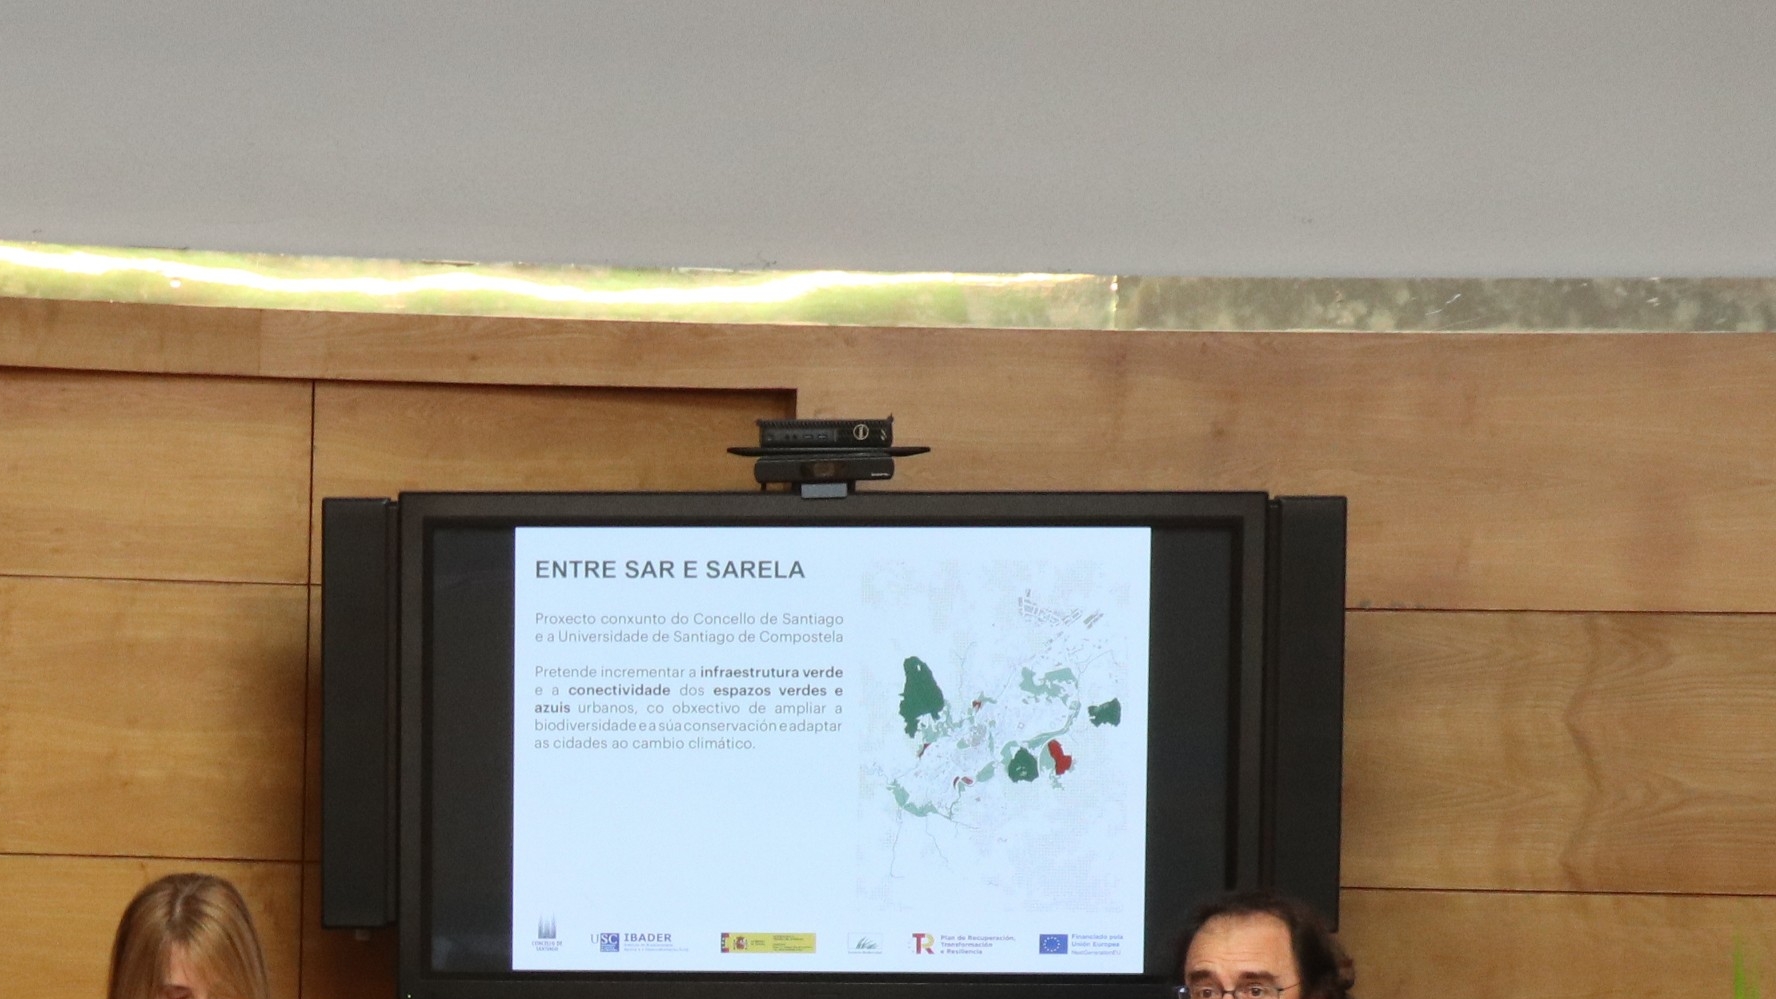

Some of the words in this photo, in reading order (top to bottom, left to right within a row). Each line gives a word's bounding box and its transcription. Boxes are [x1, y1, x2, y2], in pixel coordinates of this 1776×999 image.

[535, 560, 617, 579] ENTRE
[624, 560, 675, 579] SAR
[683, 560, 698, 579] E
[706, 560, 806, 579] SARELA
[535, 612, 596, 625] Proxecto
[601, 613, 666, 625] conxunto
[671, 612, 689, 625] do
[693, 612, 756, 625] Concello
[760, 612, 778, 625] de
[782, 612, 844, 628] Santiago
[535, 632, 544, 643] e
[547, 632, 555, 643] a
[558, 630, 649, 643] Universidade
[652, 630, 670, 643] de
[673, 630, 735, 646] Santiago
[738, 630, 756, 643] de
[759, 630, 843, 645] Compostela
[535, 665, 597, 679] Pretende
[601, 666, 685, 679] incrementar
[688, 668, 697, 679] a
[700, 665, 799, 679] infraestrutura
[803, 665, 843, 679] verde
[534, 685, 543, 696] e
[551, 685, 560, 696] a
[568, 683, 671, 696] conectividade
[679, 683, 705, 696] dos
[713, 685, 771, 699] espazos
[779, 683, 827, 696] verdes
[834, 685, 843, 696] e
[534, 701, 571, 714] azuis
[578, 701, 638, 716] urbanos,
[646, 703, 664, 714] co
[672, 701, 740, 714] obxectivo
[748, 701, 766, 714] de
[774, 701, 826, 716] ampliar
[834, 703, 842, 714] a
[534, 719, 637, 732] biodiversidade
[638, 721, 647, 732] e
[648, 721, 656, 732] a
[658, 719, 682, 732] súa
[683, 719, 777, 732] conservación
[778, 721, 788, 732] e
[789, 719, 842, 734] adaptar
[534, 738, 549, 749] as
[553, 736, 608, 749] cidades
[611, 738, 628, 749] ao
[632, 736, 685, 749] cambio
[688, 736, 756, 749] climático.
[624, 933, 672, 942] IBADER
